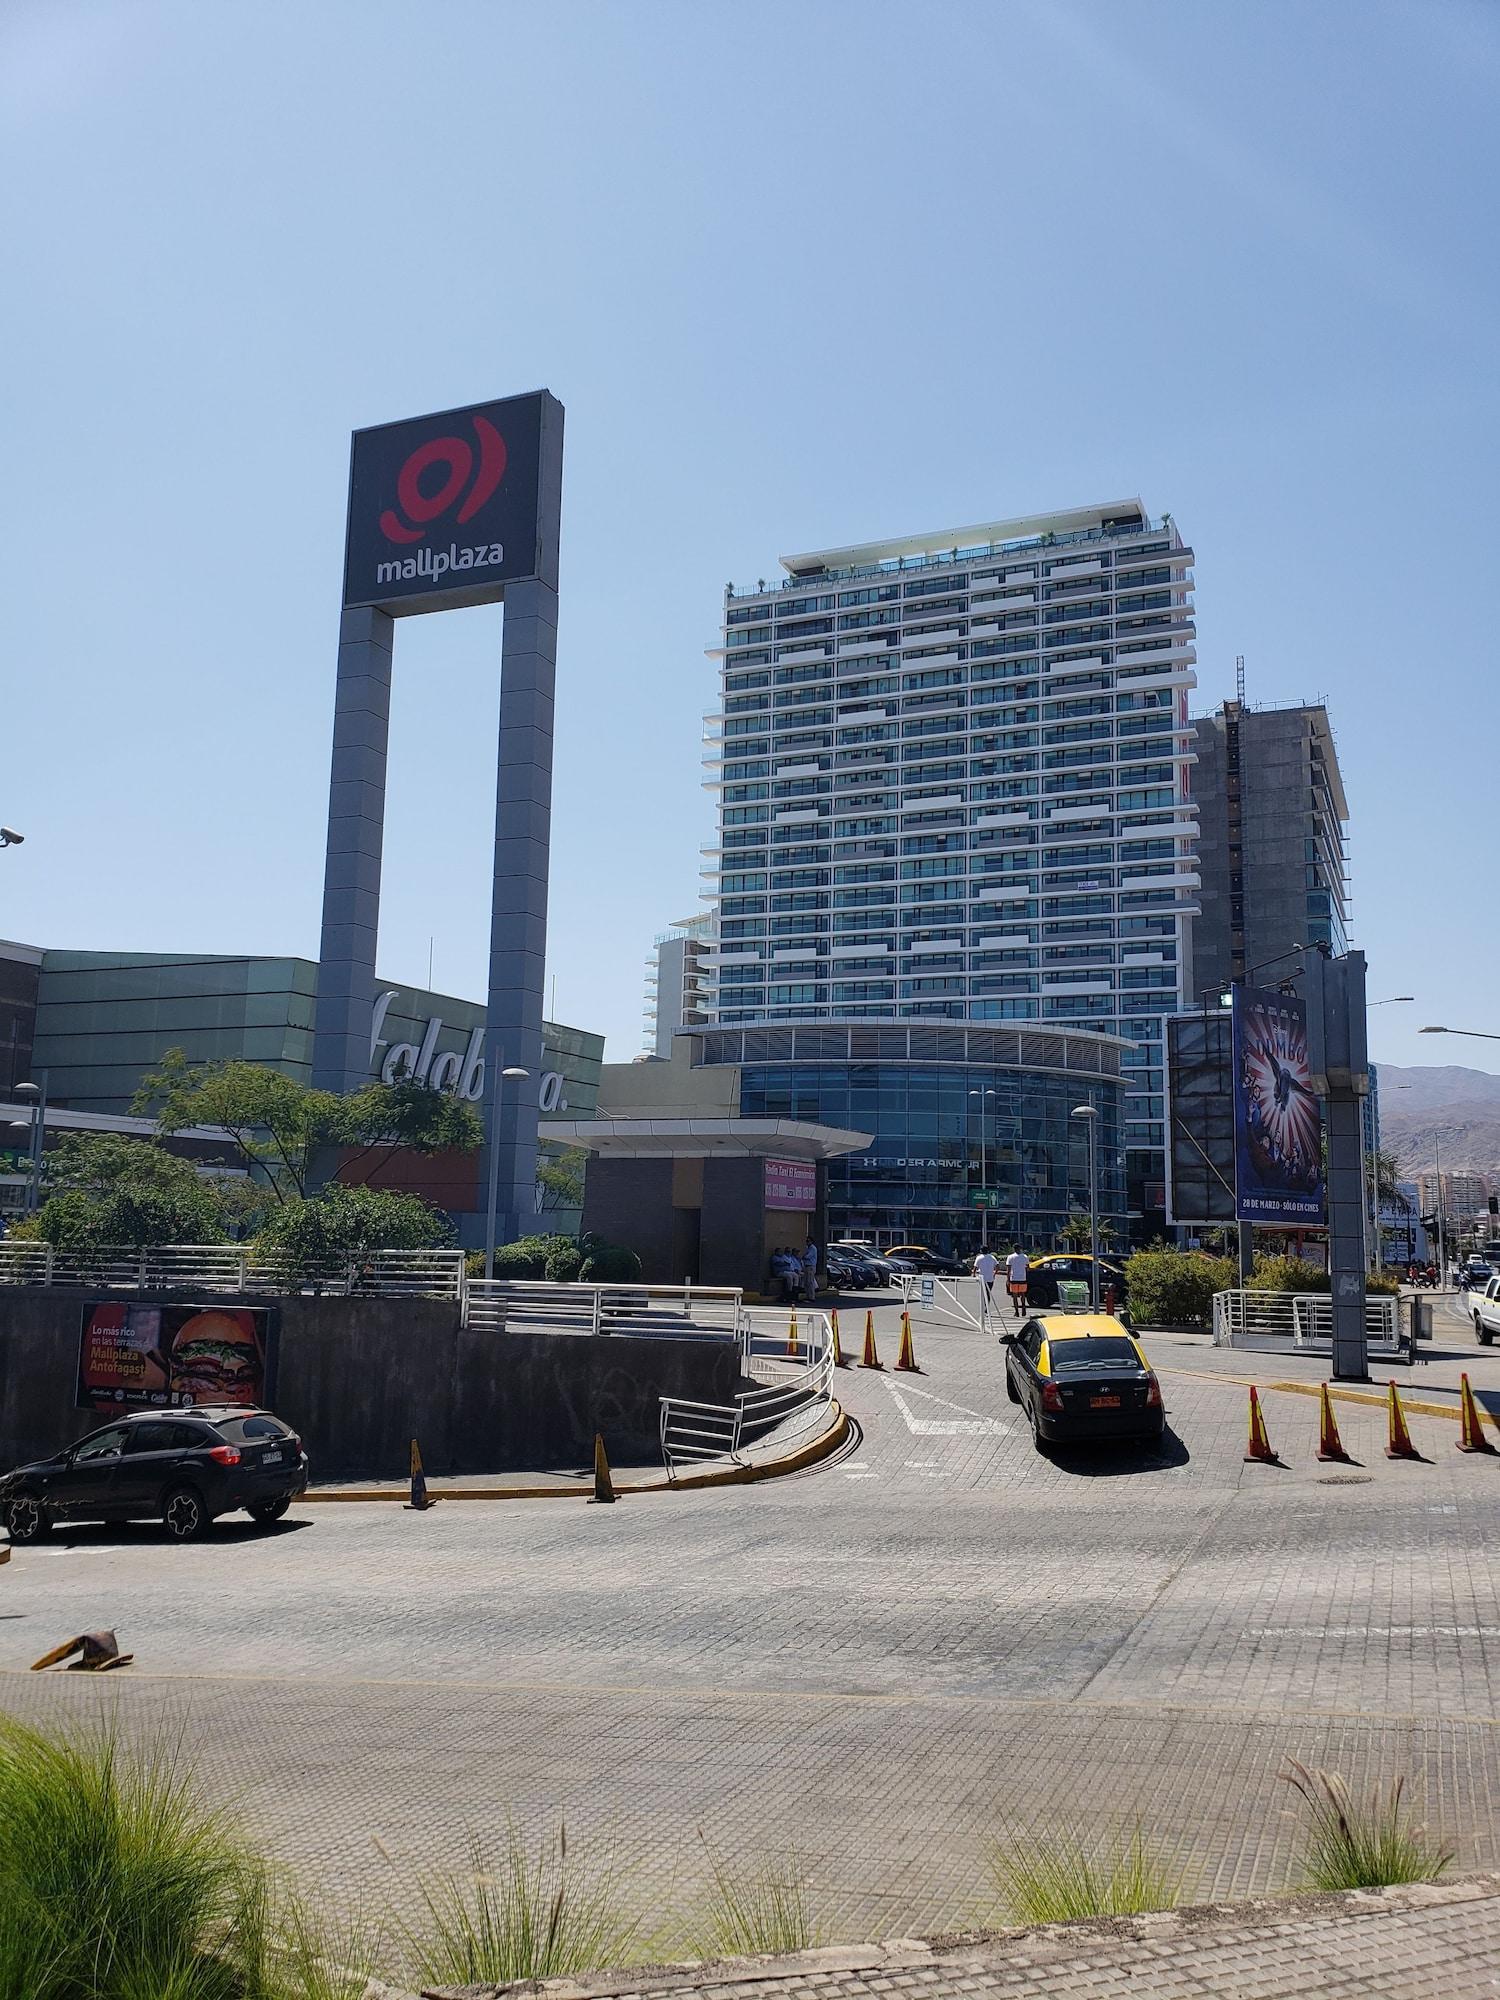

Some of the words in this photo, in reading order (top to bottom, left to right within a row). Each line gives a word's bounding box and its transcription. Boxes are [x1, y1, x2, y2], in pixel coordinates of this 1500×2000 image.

[376, 542, 504, 583] mallplaza
[369, 990, 568, 1113] falaba.
[1256, 1039, 1305, 1065] DUMBO
[1242, 1199, 1250, 1208] 28
[1251, 1200, 1259, 1209] DE
[1260, 1200, 1280, 1210] MARZO
[1283, 1200, 1297, 1211] SÓLO
[1297, 1203, 1304, 1212] EN
[1305, 1203, 1320, 1213] CINES
[92, 1325, 101, 1335] Lo
[102, 1326, 119, 1336] más
[119, 1326, 136, 1337] rico
[102, 1337, 112, 1346] las
[113, 1338, 143, 1348] terrazas
[90, 1346, 139, 1361] Mallplaza
